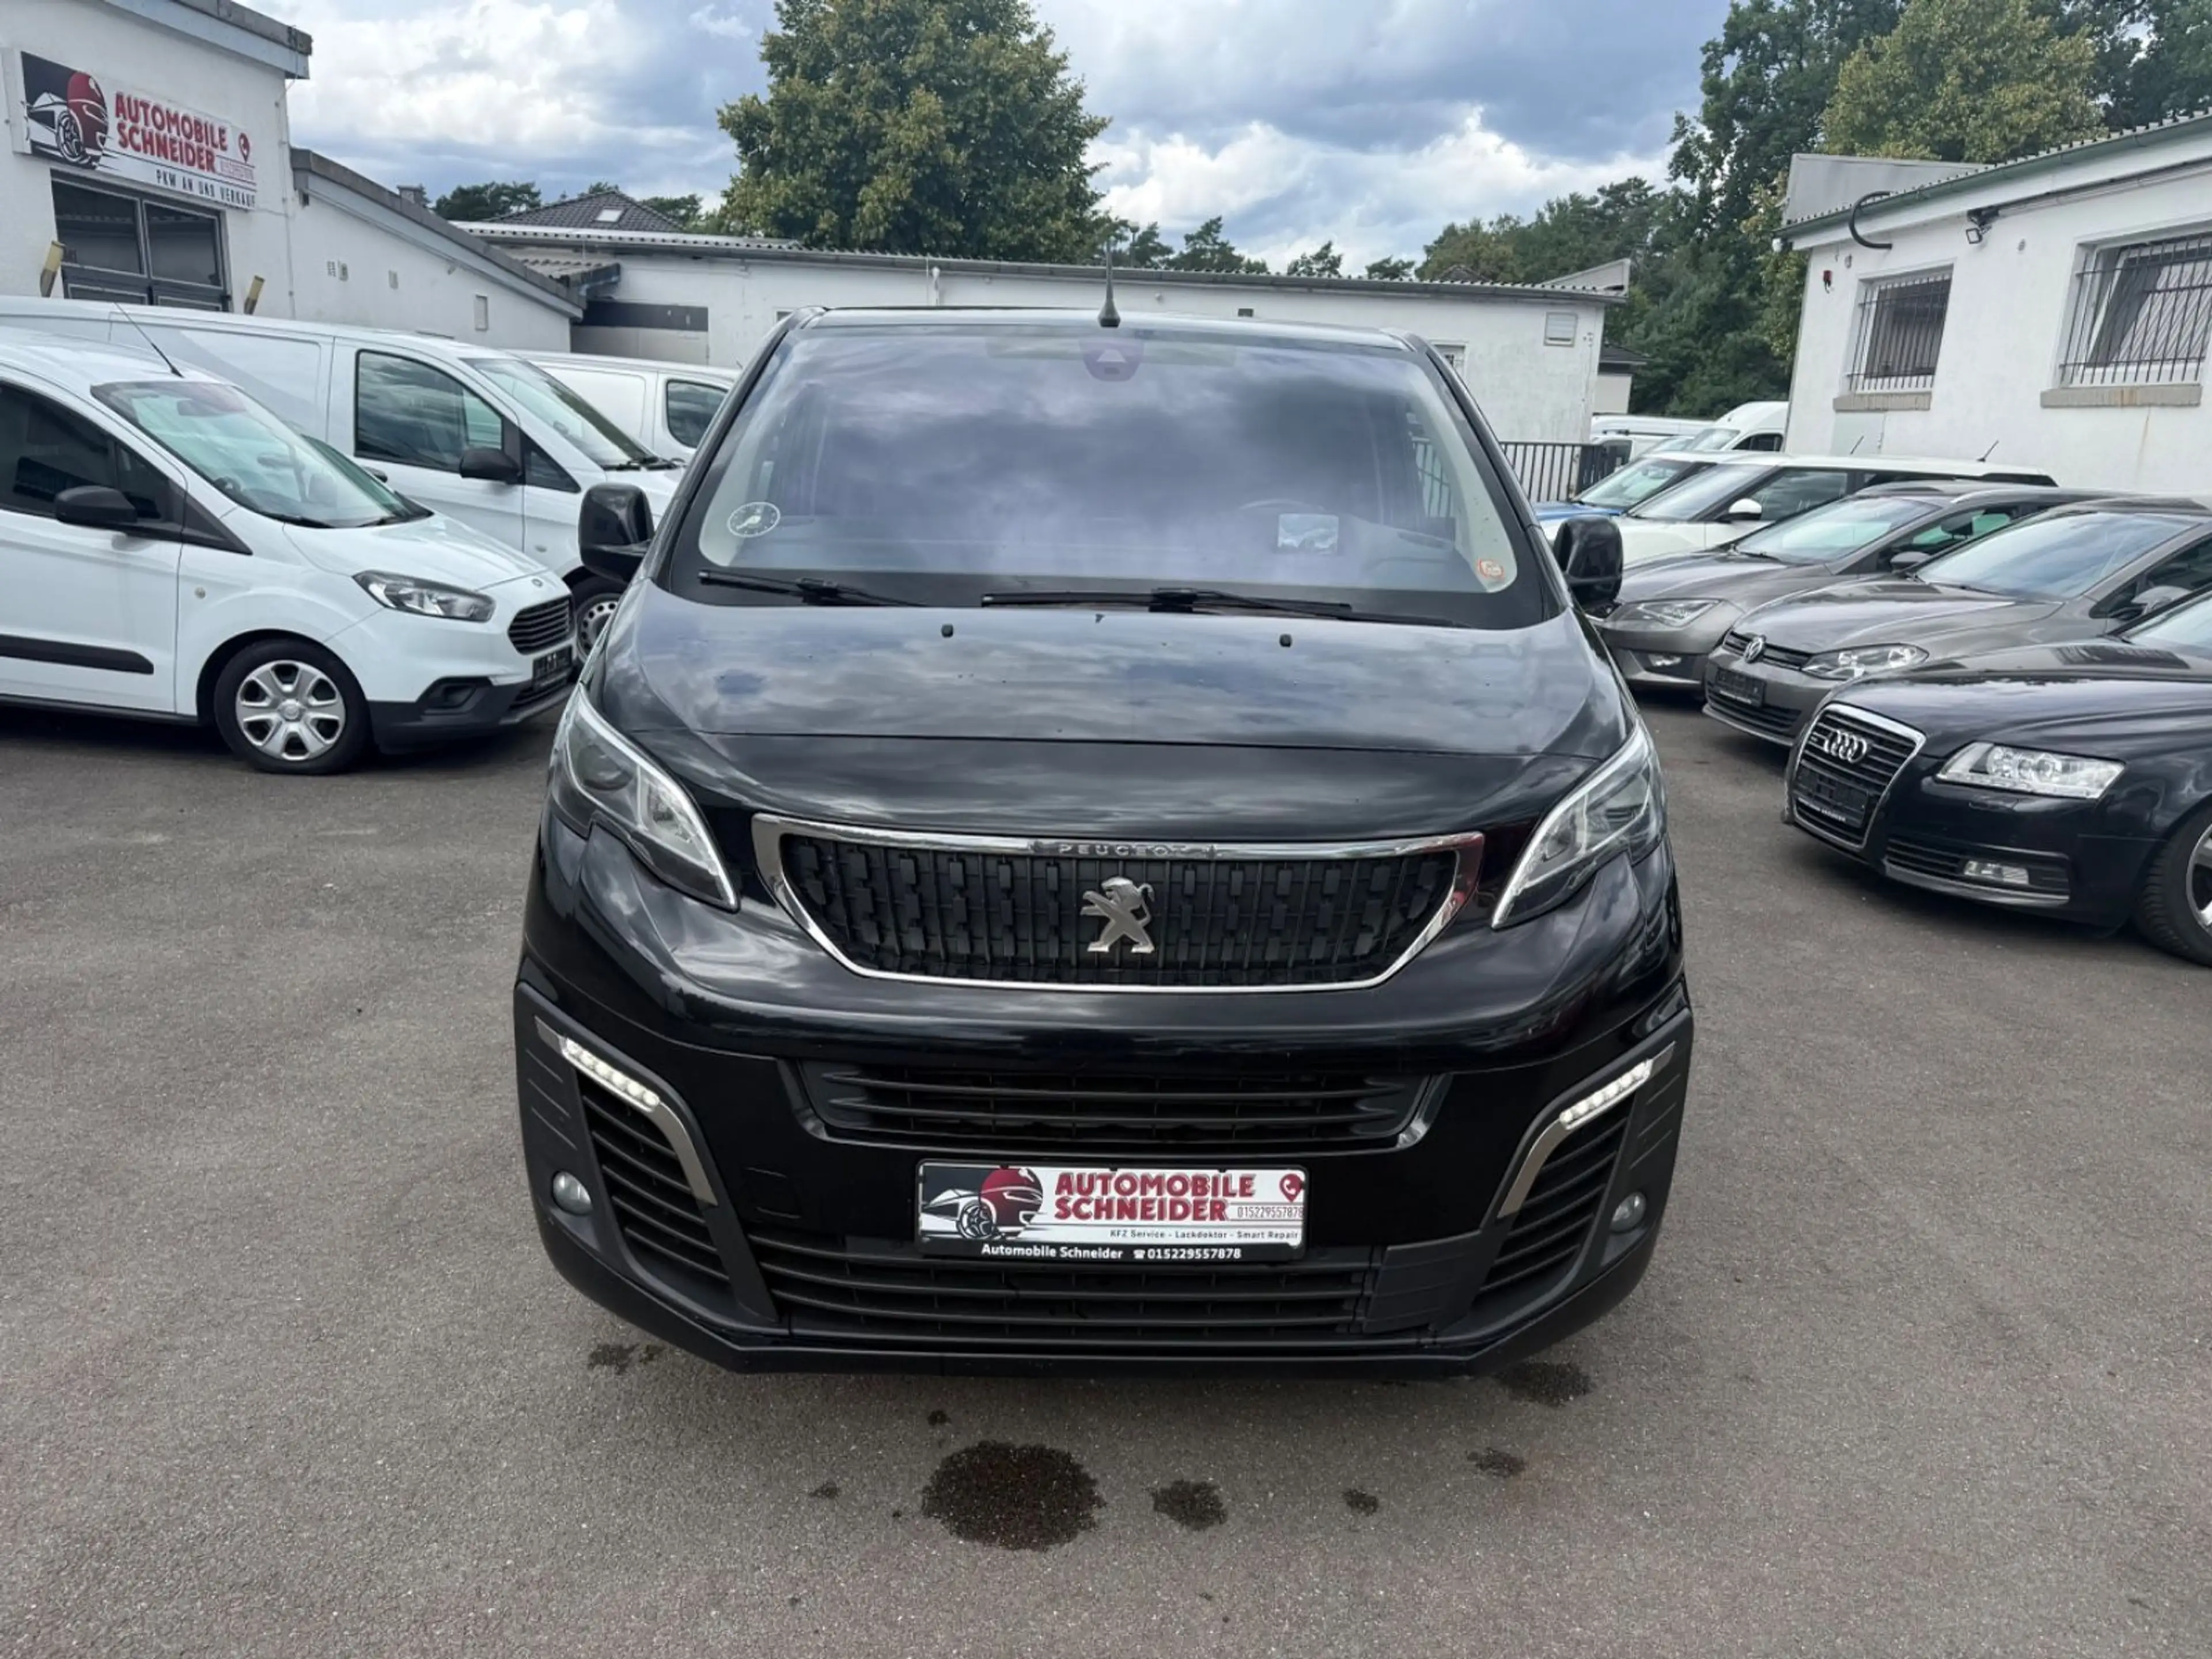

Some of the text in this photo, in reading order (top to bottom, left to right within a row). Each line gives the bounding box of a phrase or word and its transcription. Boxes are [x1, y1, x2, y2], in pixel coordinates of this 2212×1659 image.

[115, 92, 228, 151] AUTOMOBILE
[117, 122, 215, 173] SCHNEIDER
[1058, 843, 1187, 857] PEUGEOT
[1055, 1172, 1256, 1198] AUTOMOBILE
[1054, 1196, 1229, 1221] SCHNEIDER
[1110, 1229, 1127, 1238] KFZ
[1130, 1230, 1165, 1238] Service
[1175, 1230, 1228, 1239] Lackdoktor
[1237, 1231, 1266, 1239] Smart
[1267, 1231, 1299, 1241] Repair
[981, 1243, 1242, 1260] Automobile Schneider 015229557878
